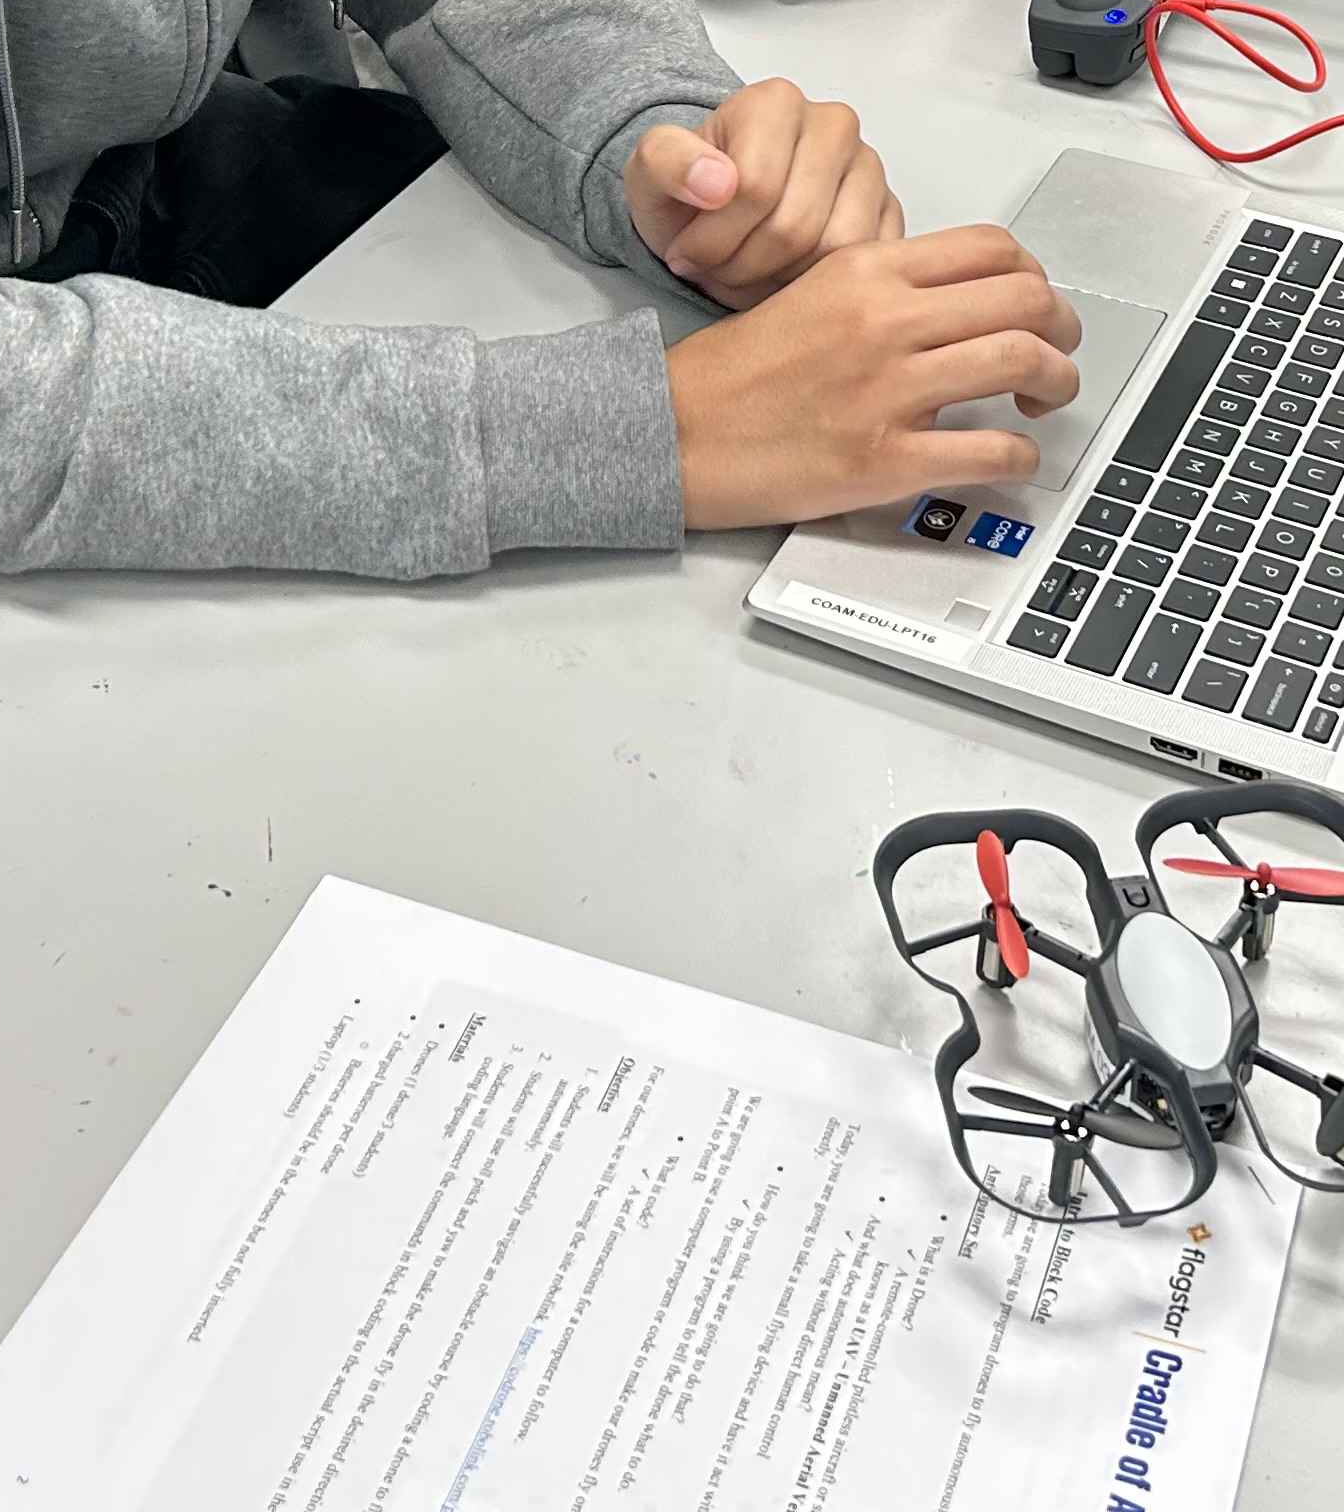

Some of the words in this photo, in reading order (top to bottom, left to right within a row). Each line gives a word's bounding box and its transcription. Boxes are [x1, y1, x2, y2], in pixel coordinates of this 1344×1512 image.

[1280, 291, 1298, 302] Z
[1264, 317, 1284, 329] X
[1323, 317, 1341, 329] S
[1250, 345, 1268, 356] C
[1310, 344, 1328, 356] D
[1236, 373, 1254, 384] V
[1296, 372, 1313, 384] F
[1219, 399, 1238, 412] B
[1279, 401, 1298, 413] G
[1202, 428, 1222, 443] N
[1264, 429, 1283, 442] H
[1323, 438, 1341, 450] Y
[1185, 458, 1206, 474] M
[1248, 460, 1265, 472] J
[1307, 467, 1327, 481] U
[1231, 490, 1252, 504] K
[1276, 531, 1295, 544] O
[1261, 564, 1279, 578] P
[811, 597, 937, 644] COAM-EDU-LPT16
[444, 1012, 488, 1065] Materials
[593, 1054, 638, 1115] Objectives
[654, 1152, 681, 1185] What
[822, 1159, 844, 1183] you
[649, 1182, 667, 1196] is
[756, 1182, 782, 1213] How
[818, 1182, 835, 1203] are
[633, 1194, 662, 1231] code?
[749, 1210, 770, 1229] do
[802, 1200, 831, 1237] going
[722, 1215, 746, 1236] By
[860, 1213, 884, 1241] And
[1059, 1227, 1075, 1243] to
[707, 1233, 737, 1268] using
[737, 1226, 759, 1251] you
[800, 1234, 816, 1250] to
[921, 1232, 946, 1266] What
[958, 1237, 978, 1260] Set
[1019, 1233, 1035, 1255] are
[727, 1250, 754, 1283] think
[789, 1248, 813, 1277] take
[850, 1239, 874, 1271] what
[1046, 1245, 1071, 1286] Block
[707, 1266, 721, 1276] a
[785, 1273, 800, 1285] a
[816, 1246, 848, 1289] Acting
[893, 1265, 911, 1281] A
[916, 1264, 934, 1278] is
[1004, 1252, 1031, 1290] going
[718, 1281, 737, 1302] we
[839, 1268, 863, 1299] does
[863, 1259, 890, 1301] known
[913, 1276, 927, 1287] a
[1156, 1243, 1206, 1340] flagstar
[682, 1274, 717, 1327] program
[773, 1283, 800, 1319] small
[857, 1299, 872, 1316] as
[1003, 1287, 1019, 1304] to
[1034, 1286, 1059, 1326] Code
[710, 1300, 730, 1323] are
[802, 1286, 833, 1334] without
[854, 1315, 867, 1325] a
[897, 1286, 927, 1333] Drone?
[679, 1326, 697, 1342] to
[754, 1316, 787, 1356] flying
[812, 1296, 850, 1370] autonomous
[855, 1278, 905, 1385] remote-controlled
[983, 1299, 1016, 1355] program
[692, 1320, 724, 1359] going
[789, 1332, 816, 1371] direct
[841, 1325, 867, 1361] UAV
[670, 1340, 693, 1364] tell
[661, 1362, 684, 1385] the
[689, 1357, 707, 1373] to
[741, 1354, 772, 1398] device
[973, 1353, 1001, 1397] drones
[681, 1371, 704, 1392] do
[772, 1368, 803, 1414] human
[796, 1369, 826, 1414] mean?
[645, 1383, 676, 1422] drone
[668, 1390, 696, 1425] that?
[731, 1395, 756, 1423] and
[810, 1371, 850, 1445] Unmanned
[833, 1382, 869, 1438] pilotless
[969, 1395, 985, 1412] to
[1123, 1346, 1184, 1453] Cradle
[959, 1410, 983, 1432] fly
[631, 1421, 659, 1455] what
[719, 1420, 746, 1455] have
[754, 1412, 786, 1460] control
[624, 1454, 643, 1471] to
[714, 1453, 735, 1467] it
[793, 1444, 823, 1490] Aerial
[819, 1436, 851, 1486] aircraft
[705, 1465, 726, 1489] act
[1113, 1453, 1156, 1492] of
[813, 1484, 830, 1503] or
